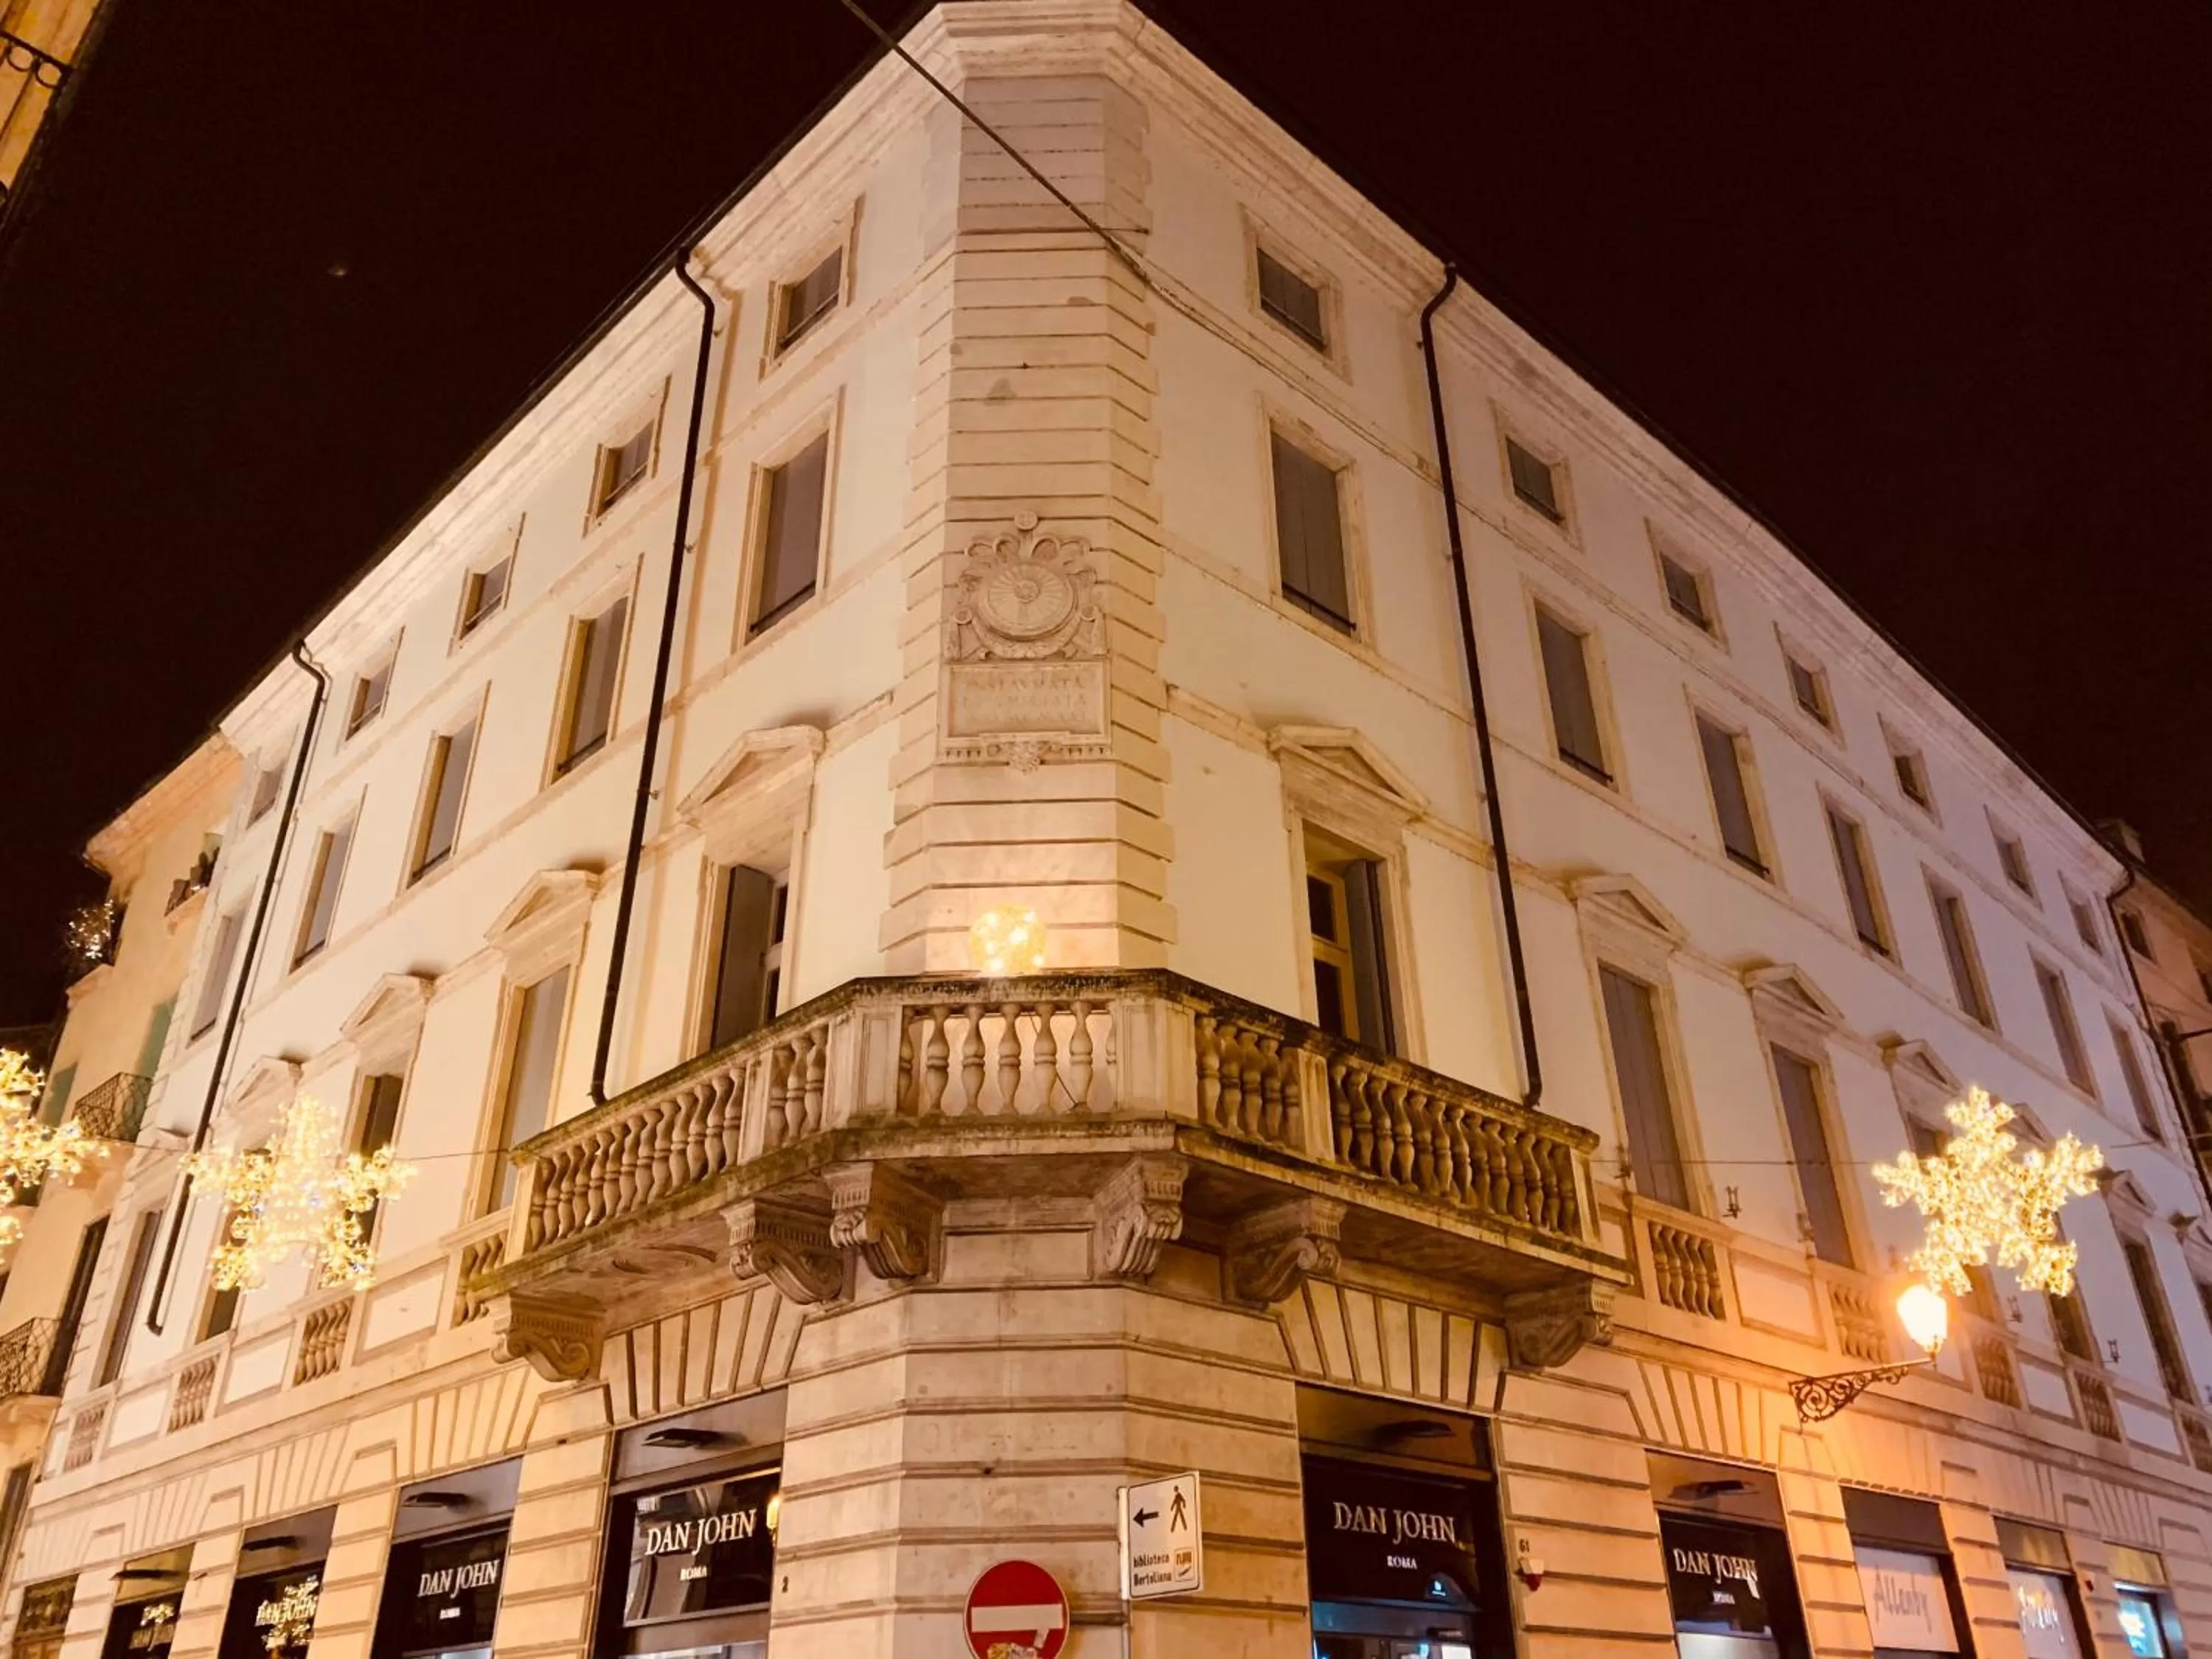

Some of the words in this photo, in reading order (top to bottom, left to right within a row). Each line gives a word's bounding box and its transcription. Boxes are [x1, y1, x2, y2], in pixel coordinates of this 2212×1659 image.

[645, 1520, 692, 1557] DAN
[691, 1508, 757, 1557] JOHN
[1332, 1500, 1387, 1535] DAN
[1392, 1509, 1455, 1545] JOHN
[417, 1568, 454, 1598] DAN
[449, 1559, 501, 1599] JOHN
[679, 1565, 709, 1582] ROMA
[1386, 1554, 1418, 1570] ROMA
[1673, 1548, 1711, 1576] DAN
[1711, 1553, 1758, 1585] JOHN
